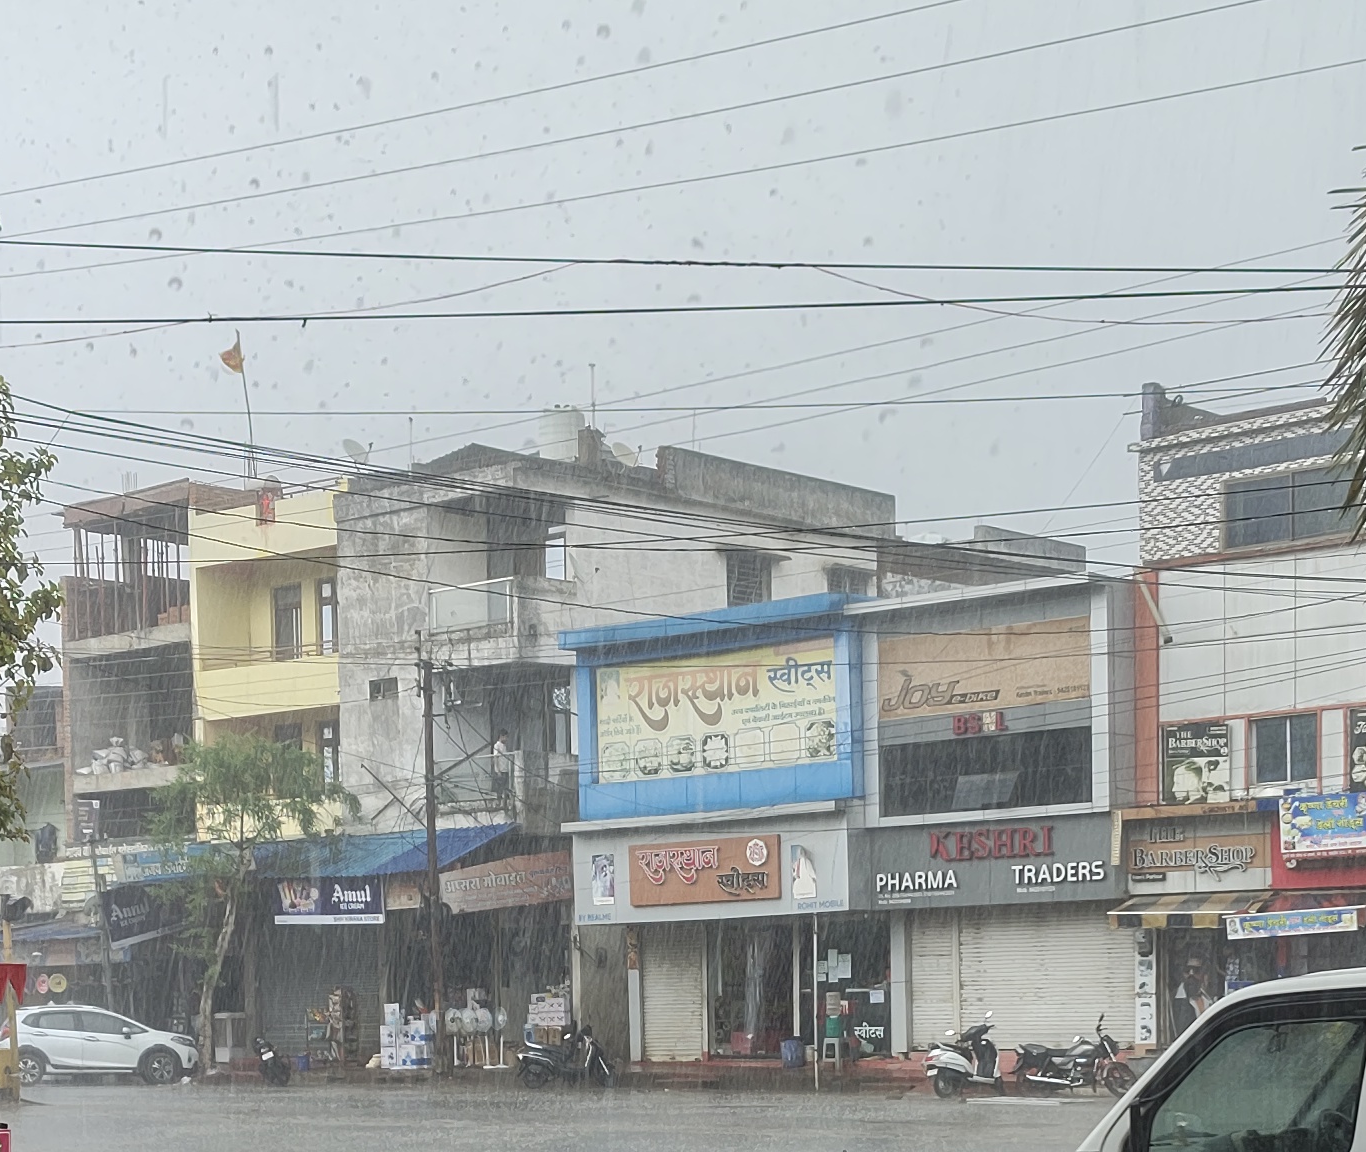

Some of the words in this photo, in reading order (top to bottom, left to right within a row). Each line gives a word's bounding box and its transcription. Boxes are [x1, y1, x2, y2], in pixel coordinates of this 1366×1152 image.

[624, 660, 760, 732] राजस्थान
[766, 656, 833, 693] स्वीट्स
[930, 825, 1055, 862] KESHRI
[636, 846, 720, 885] राजस्थान
[876, 869, 958, 892] PHARMA
[1011, 861, 1105, 885] TRADERS
[332, 884, 371, 905] Amul
